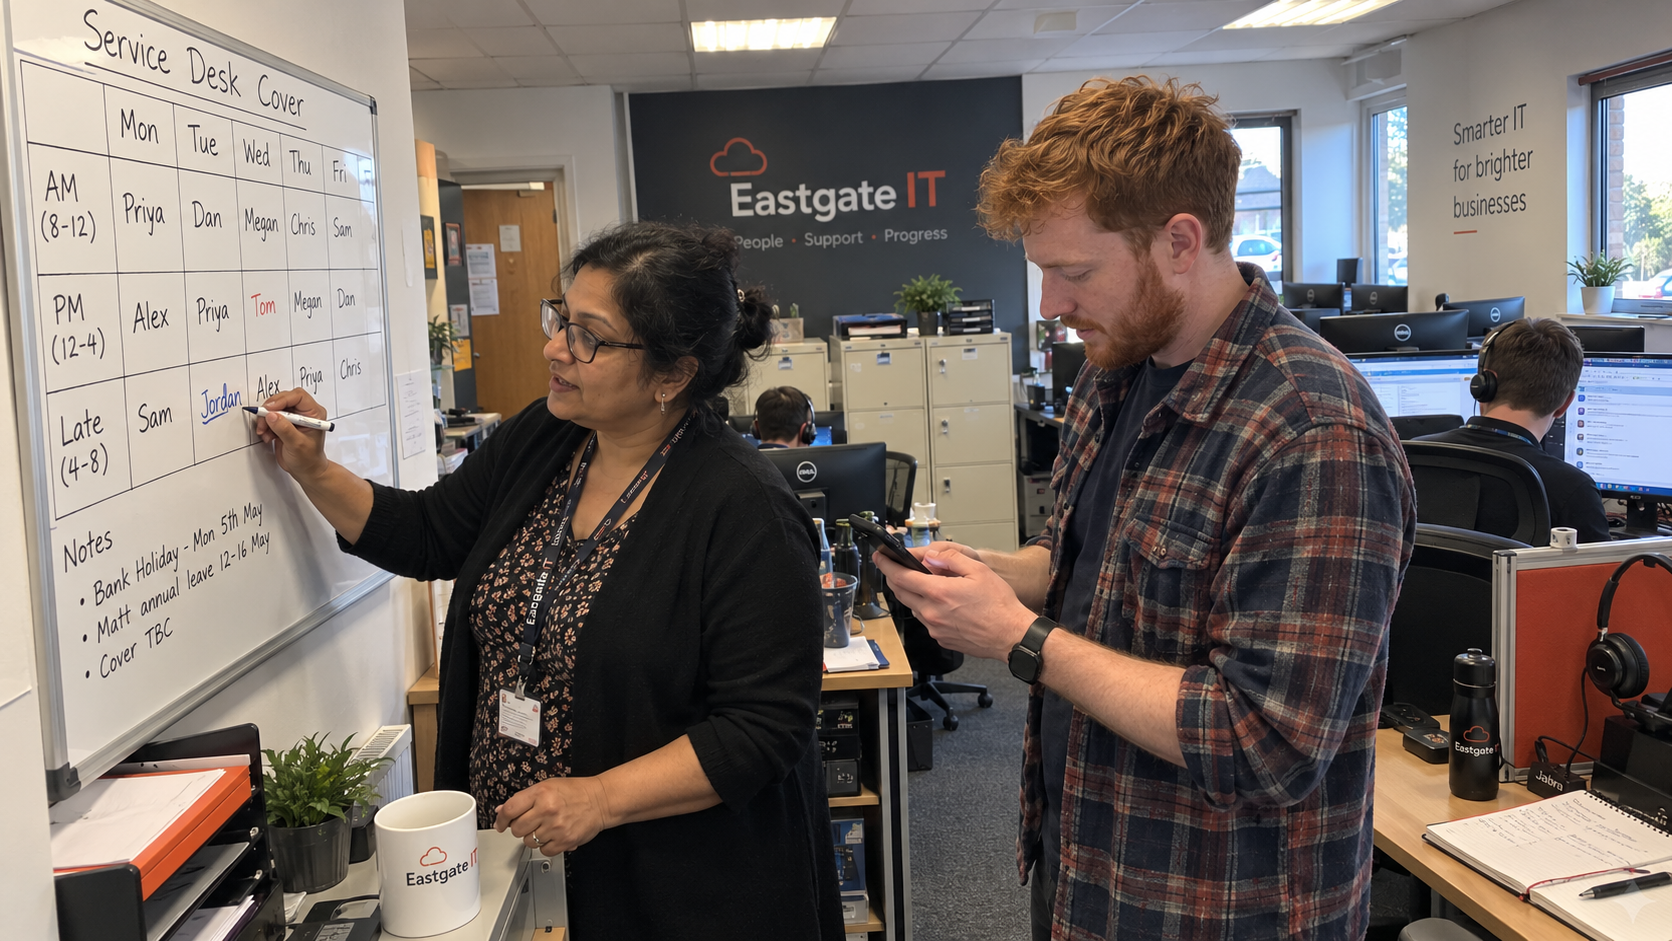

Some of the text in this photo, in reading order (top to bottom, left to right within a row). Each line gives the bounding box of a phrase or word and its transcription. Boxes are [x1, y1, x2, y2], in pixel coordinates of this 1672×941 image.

[84, 9, 304, 117] Service Desk Cover
[120, 108, 347, 183] Mon Tue Wed Thu Fri
[1453, 103, 1527, 145] Smarter IT
[1453, 148, 1533, 182] for brighter
[45, 170, 353, 242] AM Priya Dan Megan Chris Sam
[730, 170, 946, 222] Eastgate IT
[1453, 193, 1527, 218] businesses
[40, 210, 96, 243] (8-12)
[804, 231, 864, 248] Support
[884, 228, 948, 244] Progress
[53, 288, 355, 333] PM Alex Priya Tom Megan Dan
[51, 327, 105, 365] (12-4)
[60, 358, 362, 447] Late Sam Jordan Alex Priya Chris
[60, 442, 108, 488] (4-8)
[63, 529, 113, 573] Notes
[93, 568, 131, 606] Bank
[136, 544, 179, 582] Holiday
[193, 528, 215, 553] Mon
[221, 508, 238, 536] 5th
[243, 502, 263, 526] May
[97, 531, 270, 643] Matt annual leave 12-16 May
[100, 617, 173, 680] Cover TBC
[1455, 741, 1494, 757] Eastgate
[1535, 770, 1563, 792] Jabra
[406, 861, 469, 886] Eastgate
